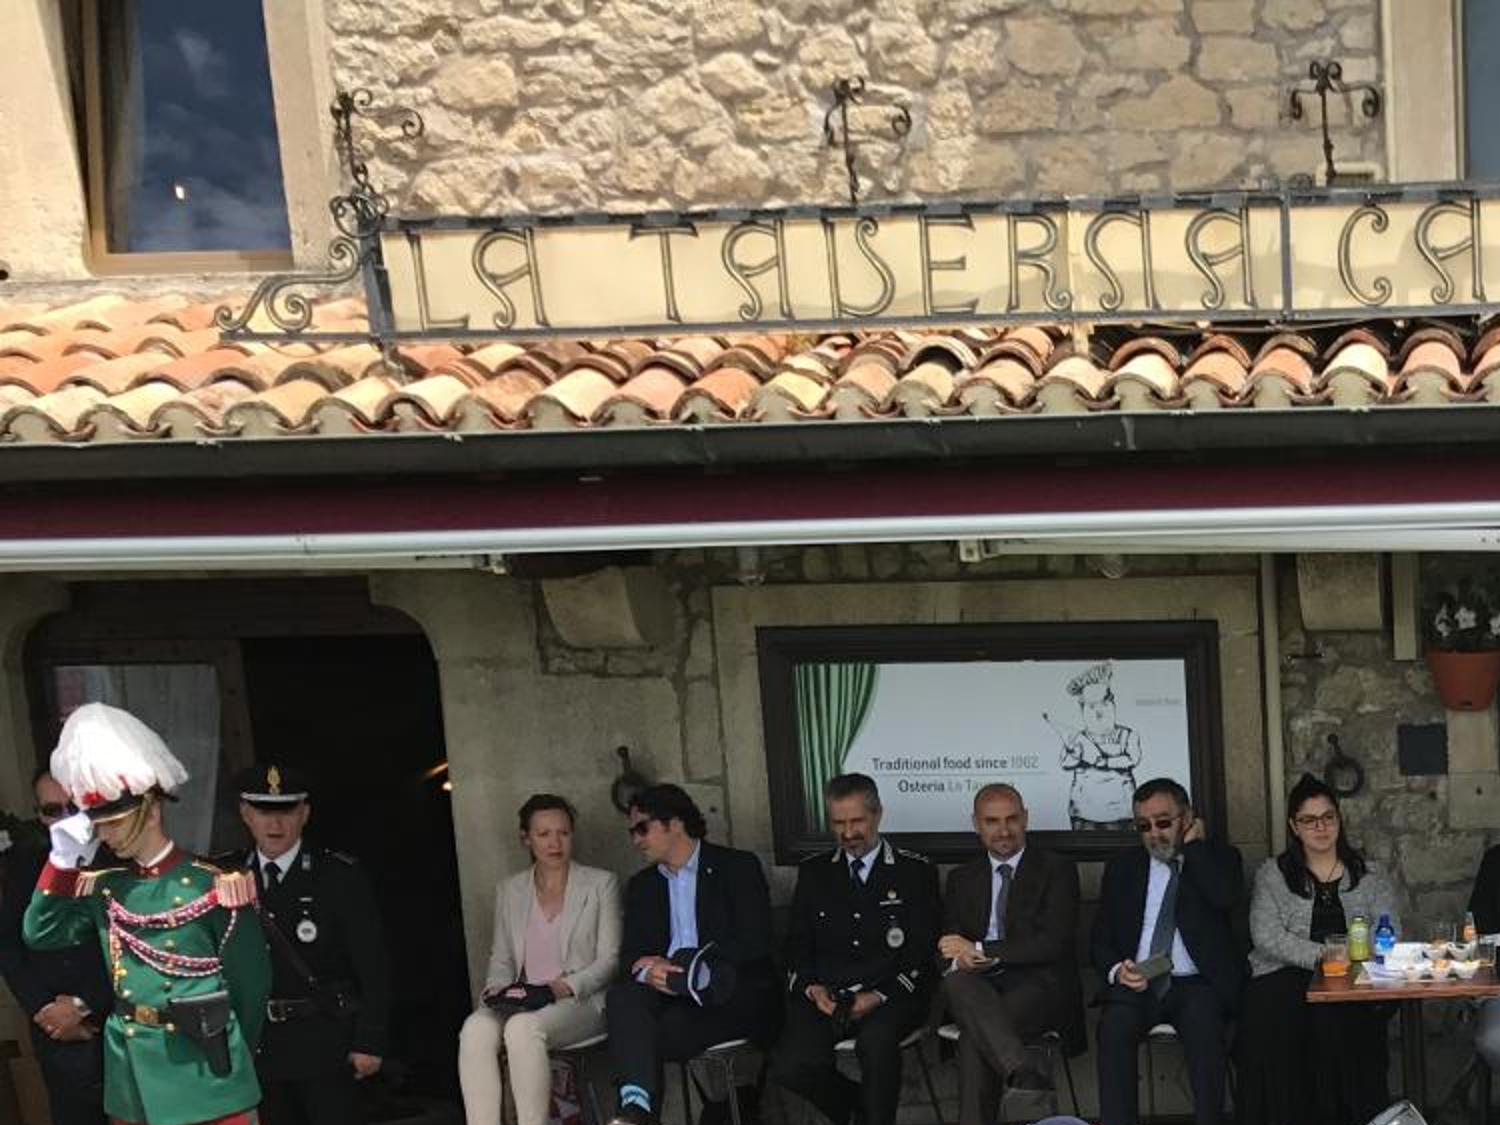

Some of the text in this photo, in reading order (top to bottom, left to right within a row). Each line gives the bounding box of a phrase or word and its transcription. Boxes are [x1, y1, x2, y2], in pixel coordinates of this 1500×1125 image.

[409, 226, 553, 332] LA
[872, 757, 942, 771] Traditional
[943, 756, 972, 769] food
[975, 758, 1008, 769] since
[897, 779, 945, 793] Osteria
